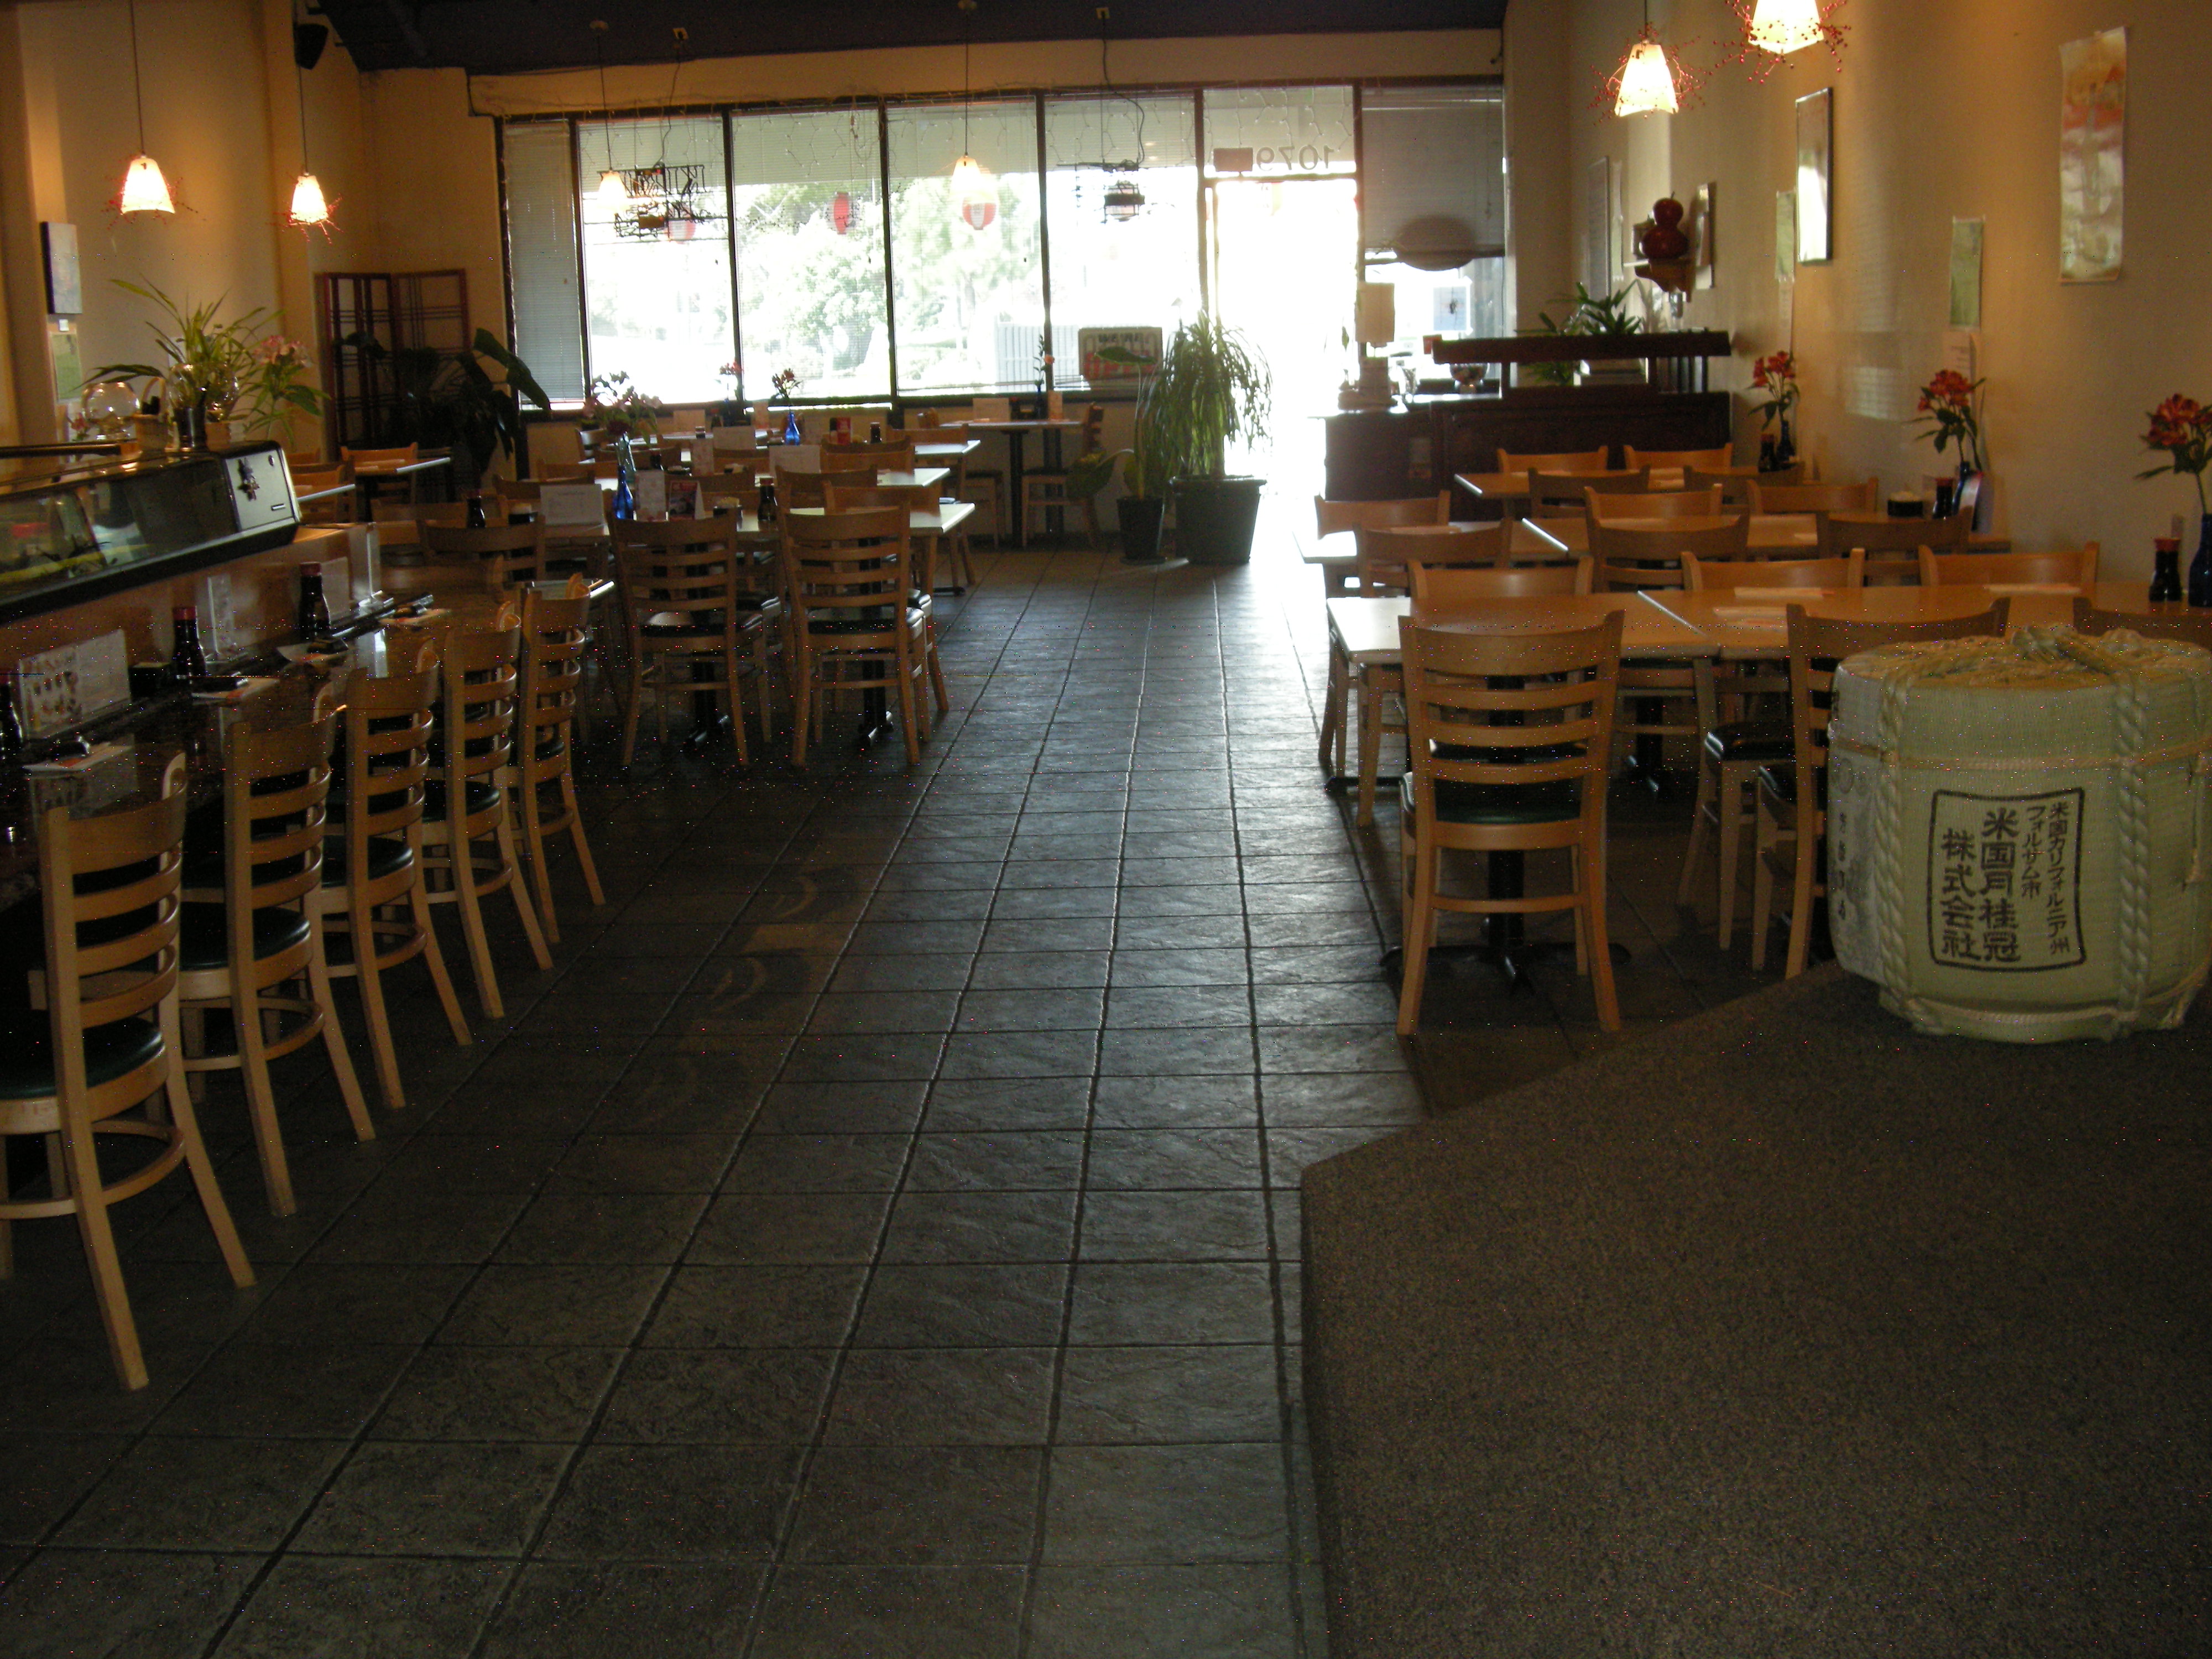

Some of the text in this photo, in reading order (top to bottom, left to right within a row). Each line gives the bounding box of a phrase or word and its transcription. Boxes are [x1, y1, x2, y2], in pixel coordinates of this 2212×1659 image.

[1940, 827, 1982, 961] 株式会社
[1978, 807, 2021, 962] 米国月桂冠
